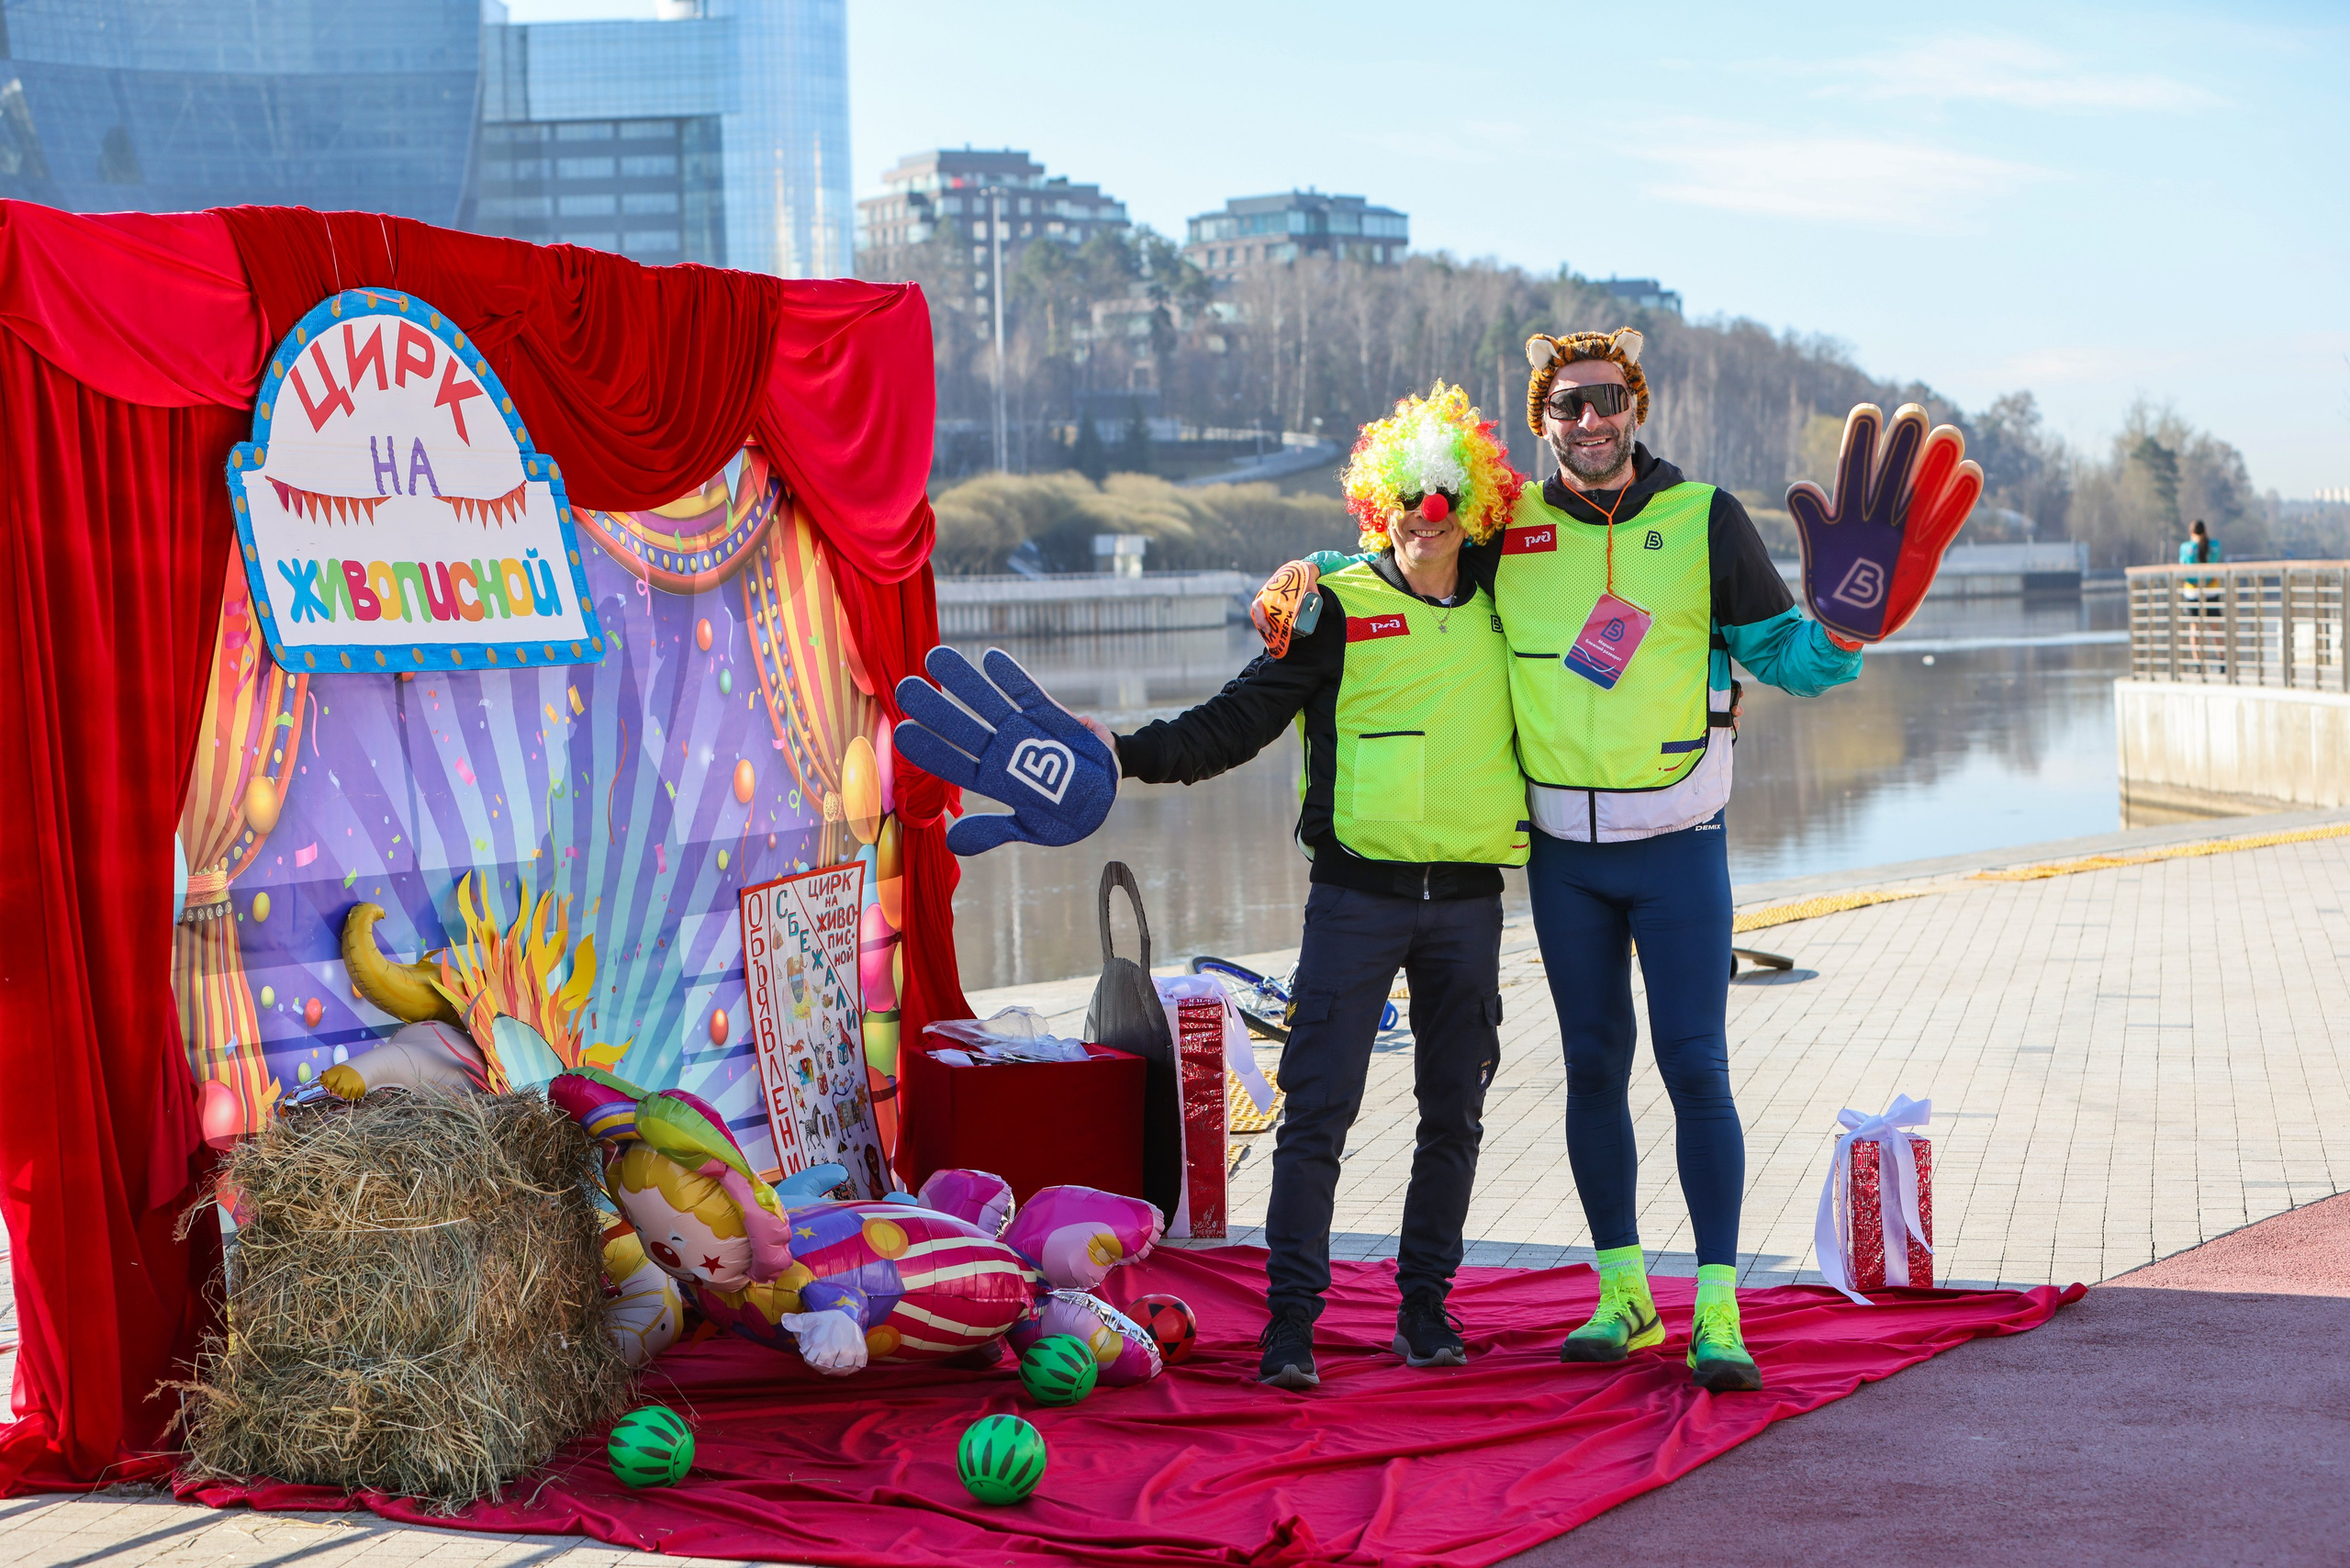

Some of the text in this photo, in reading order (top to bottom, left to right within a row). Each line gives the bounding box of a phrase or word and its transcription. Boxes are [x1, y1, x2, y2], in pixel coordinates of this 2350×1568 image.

[289, 319, 484, 447] ЦИРК
[370, 435, 442, 497] НА
[277, 547, 563, 623] ЖИВОПИСНОЙ
[1597, 639, 1616, 652] Маршал
[1695, 823, 1721, 832] DEMIX
[808, 871, 855, 901] ЦИРК
[824, 895, 838, 908] НА
[815, 906, 858, 933] ЖИВО-
[834, 946, 855, 967] НОЙ
